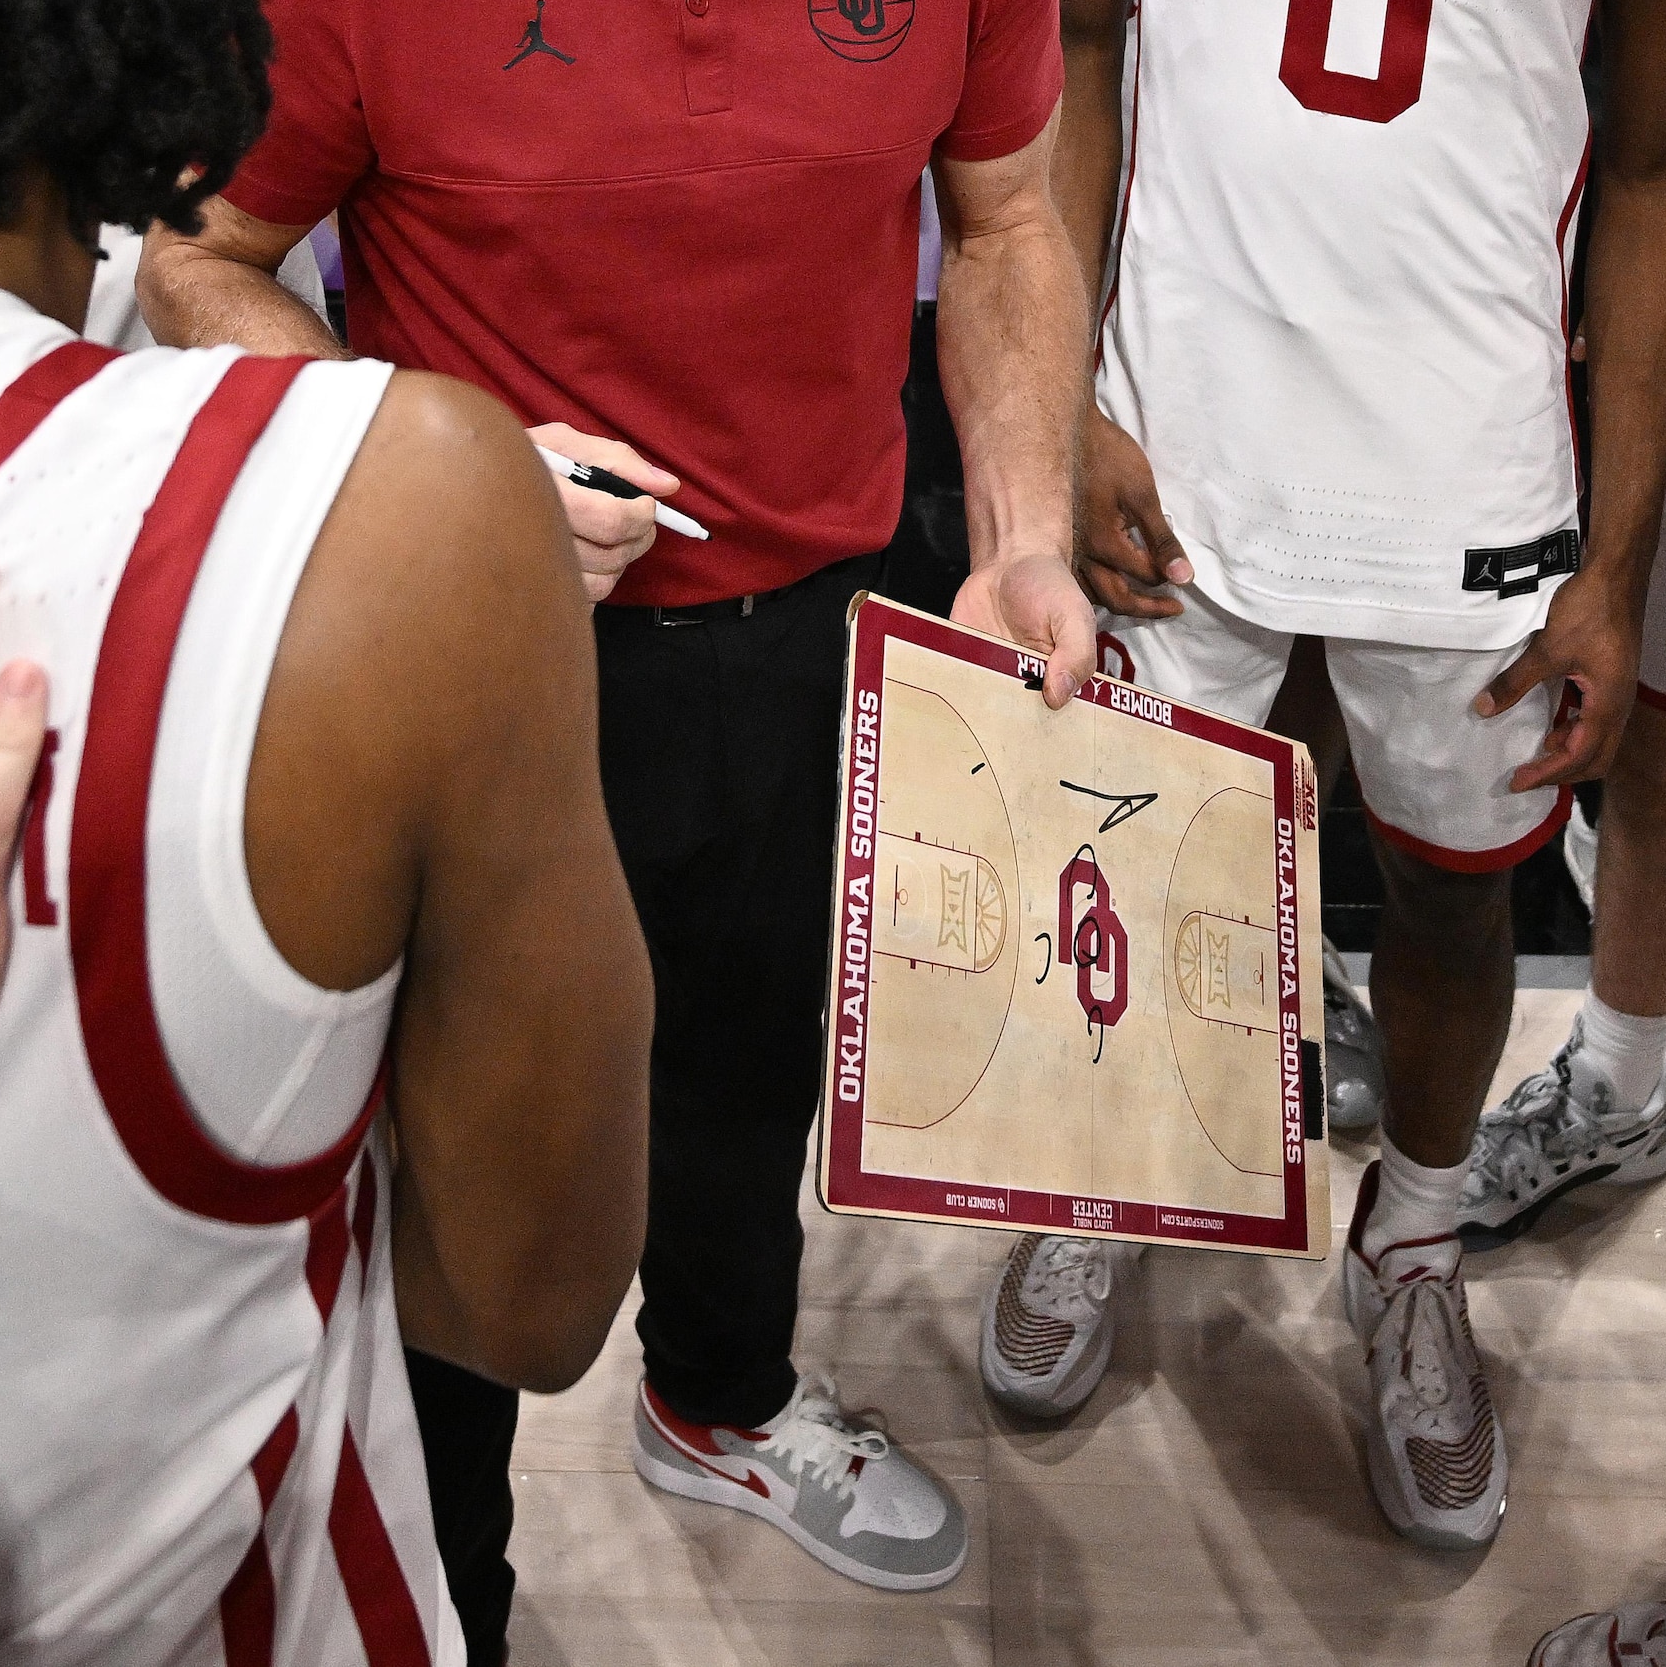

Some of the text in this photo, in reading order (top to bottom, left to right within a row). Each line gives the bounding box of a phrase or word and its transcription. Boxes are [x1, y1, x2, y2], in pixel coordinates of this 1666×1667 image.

[1110, 684, 1172, 727] BOOMER
[838, 688, 880, 1103] OKLAHOMA SOONERS
[1276, 816, 1301, 1165] OKLAHOMA SOONERS
[946, 1193, 965, 1206] CLUB
[967, 1195, 996, 1210] SOONER
[1072, 1200, 1113, 1219] CENTER
[1073, 1217, 1113, 1230] LLOYD NOBLE
[1161, 1213, 1224, 1230] SOONERSPORTS.COM
